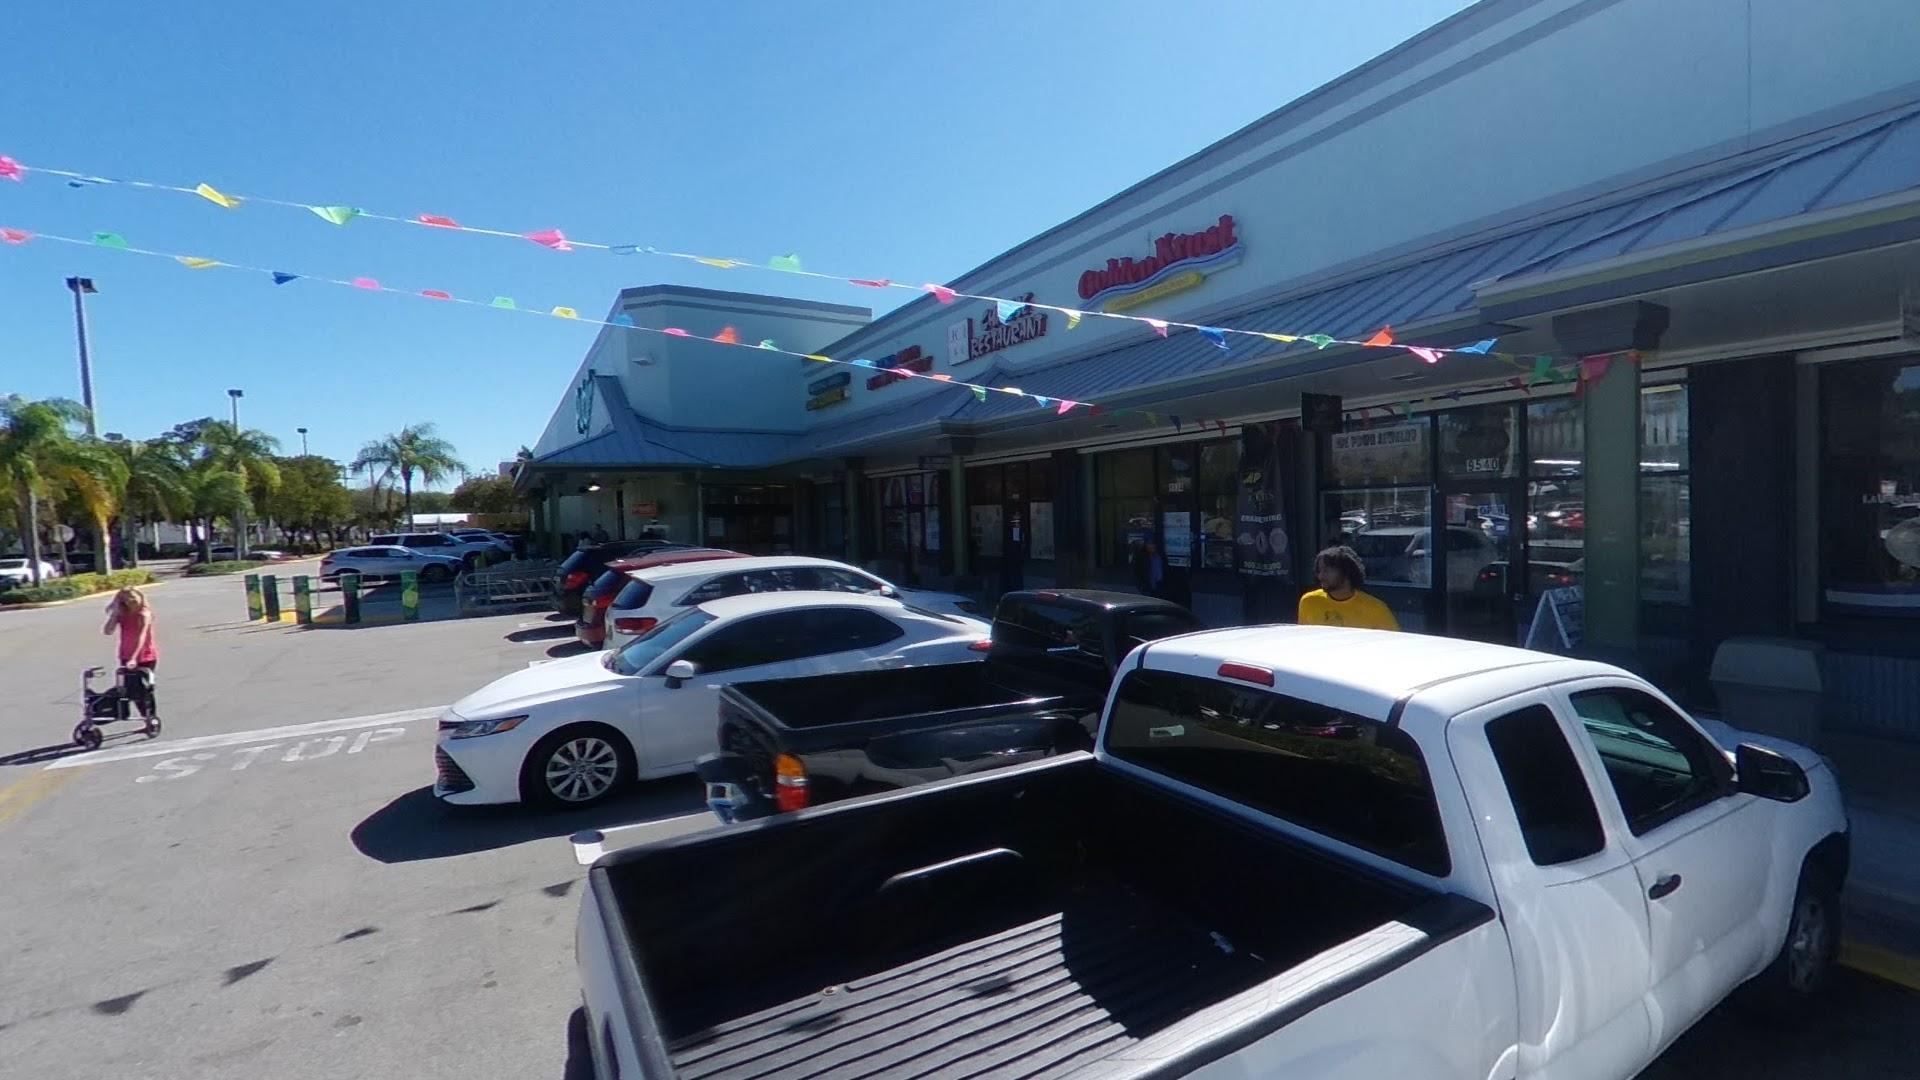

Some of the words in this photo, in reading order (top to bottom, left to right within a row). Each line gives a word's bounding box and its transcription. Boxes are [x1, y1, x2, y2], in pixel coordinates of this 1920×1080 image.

[970, 313, 1048, 359] RESTAURANT
[1467, 458, 1499, 471] 9540
[135, 727, 406, 783] STOP
